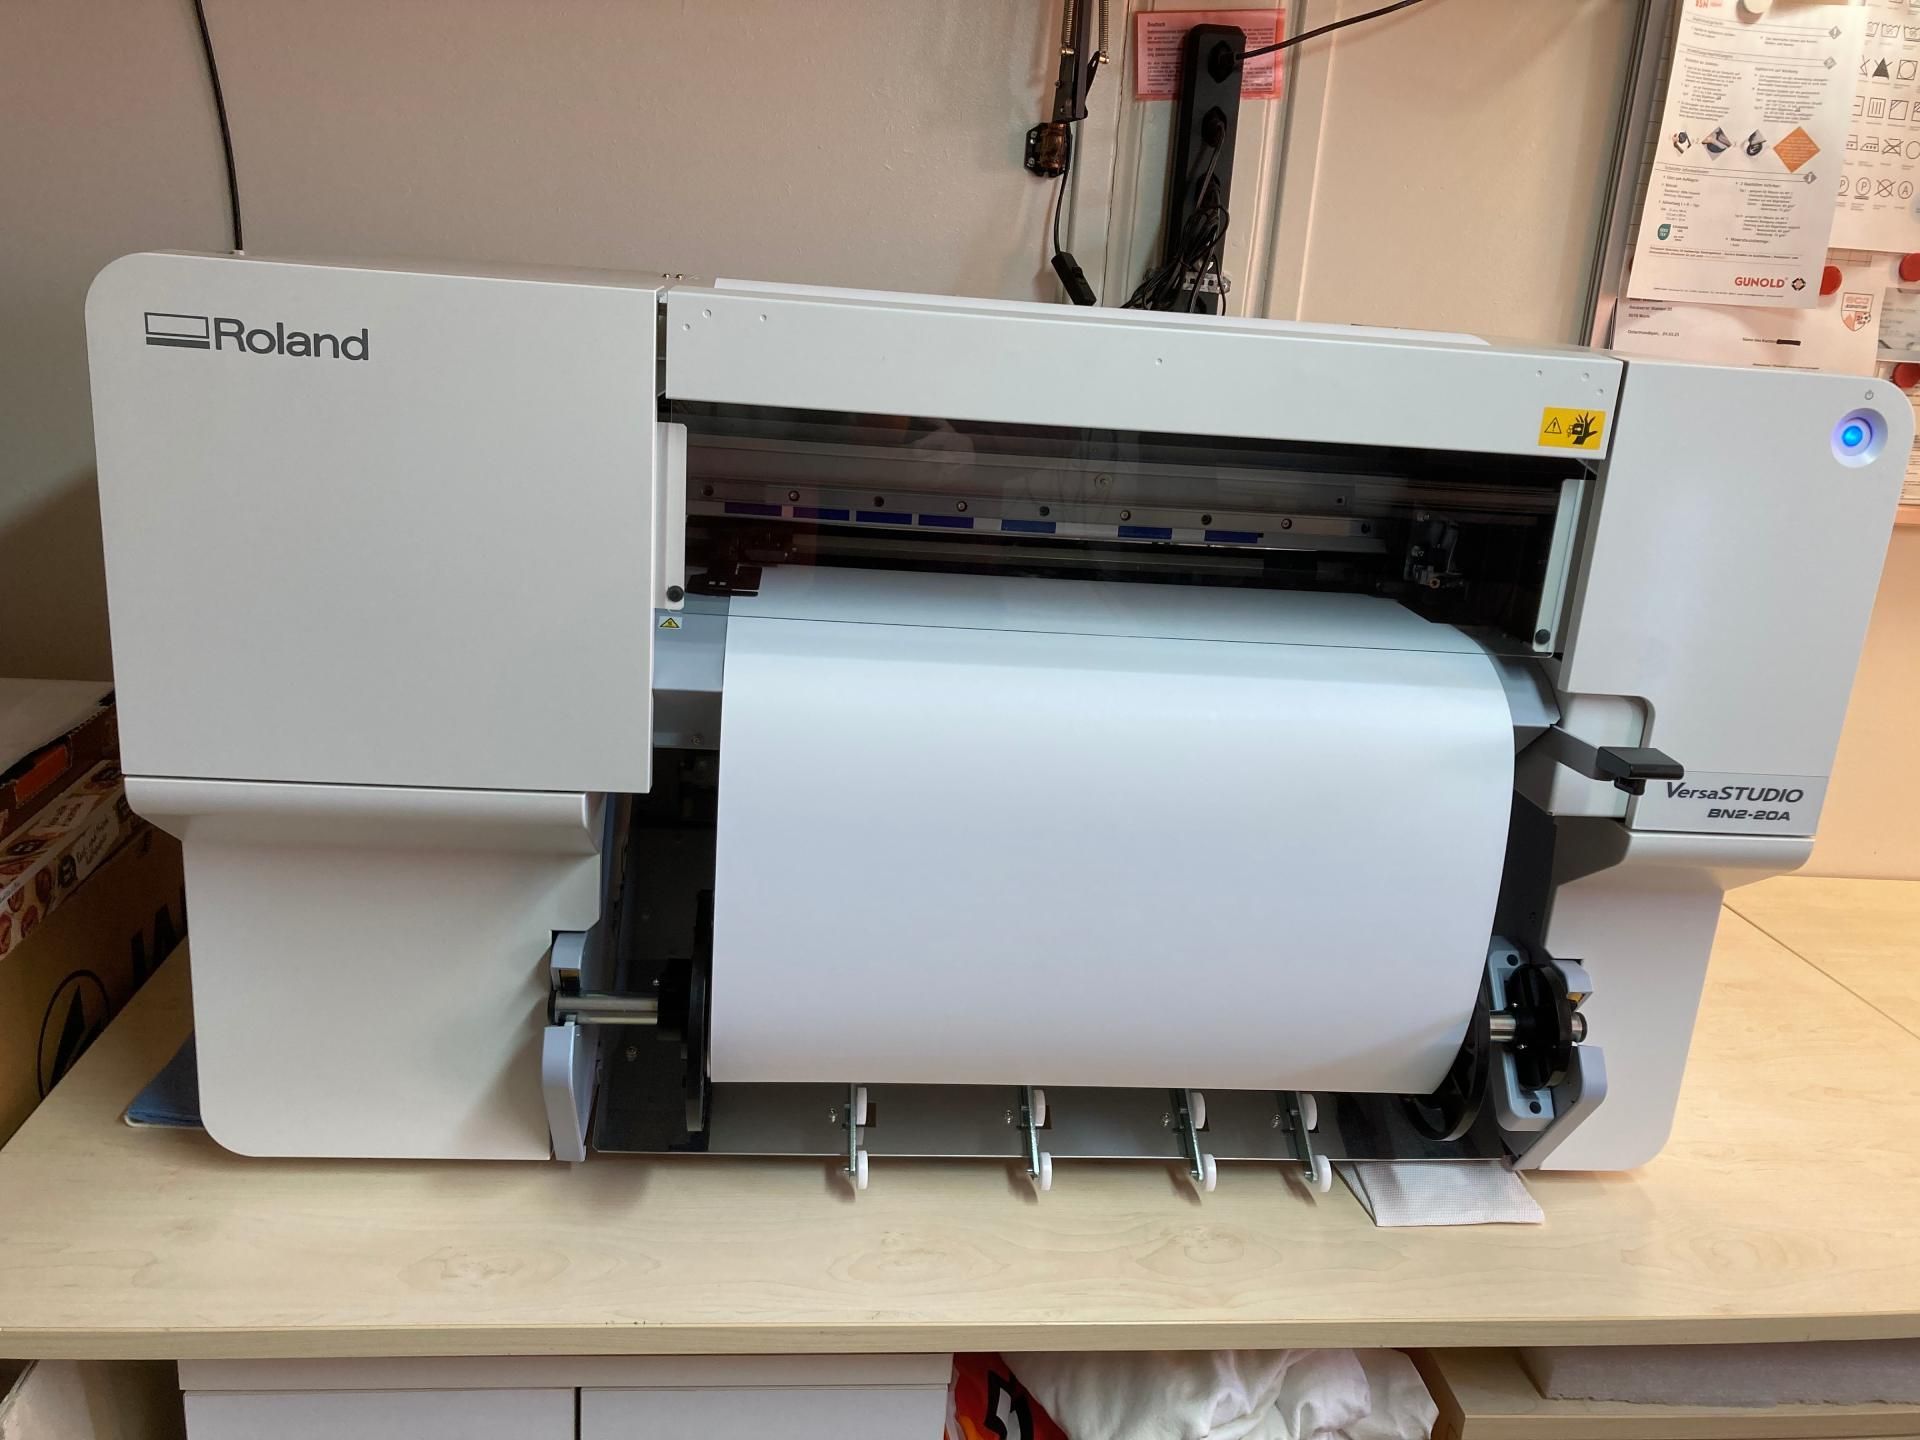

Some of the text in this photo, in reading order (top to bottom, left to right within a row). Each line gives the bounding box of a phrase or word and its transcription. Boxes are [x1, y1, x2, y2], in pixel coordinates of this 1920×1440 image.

[1734, 276, 1785, 289] GUNOLD
[213, 317, 369, 361] Roland
[1666, 781, 1804, 803] VersaSTUDIO
[1706, 808, 1791, 821] BN2-20A
